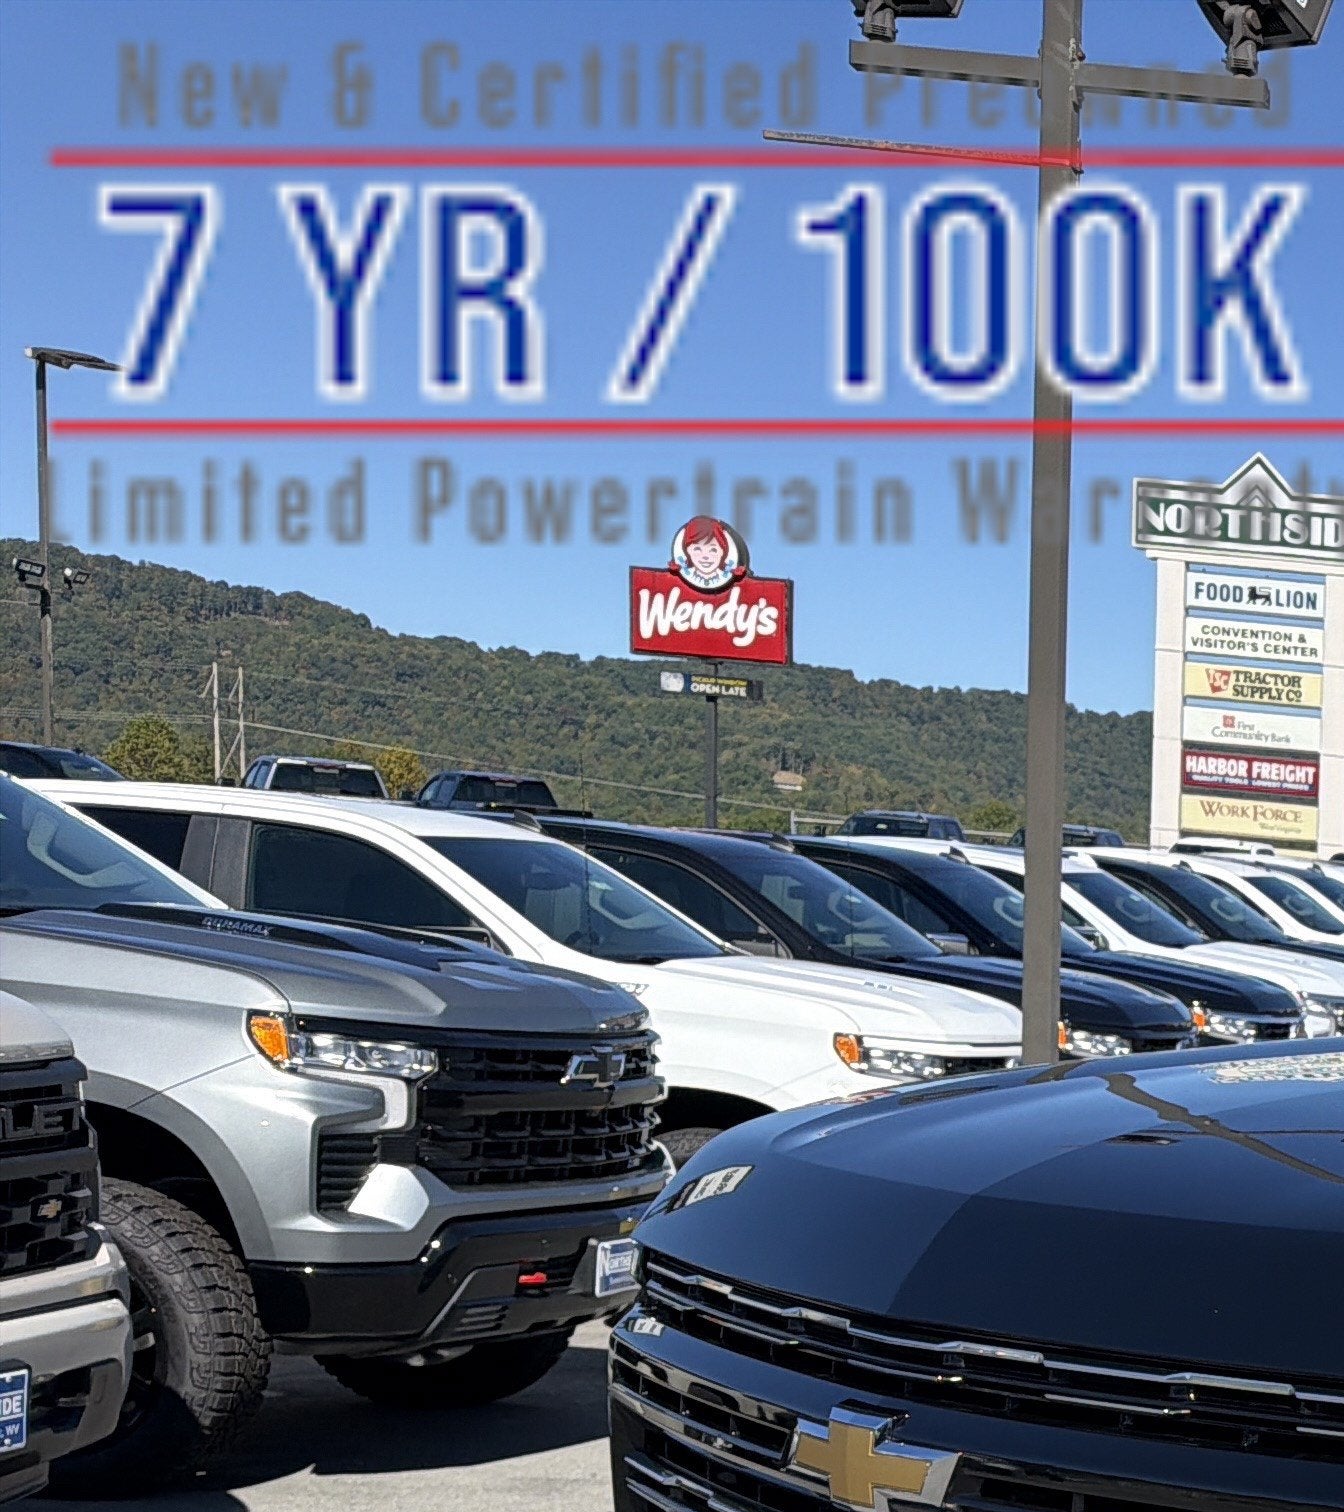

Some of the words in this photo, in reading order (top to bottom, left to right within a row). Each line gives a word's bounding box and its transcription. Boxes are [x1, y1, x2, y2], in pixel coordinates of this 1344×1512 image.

[1194, 581, 1244, 603] FOOD
[1276, 588, 1318, 610] LION
[639, 587, 779, 647] Wendy's
[1200, 624, 1293, 643] CONVENTION
[1297, 633, 1307, 644] &
[1191, 636, 1259, 652] VISITOR'S
[1263, 643, 1319, 658] CENTER
[1232, 669, 1303, 689] TRACTOR
[690, 682, 720, 694] OPEN
[721, 685, 747, 697] LATE
[1232, 684, 1285, 700] SUPPLY
[1211, 726, 1271, 743] Community
[1271, 733, 1291, 744] Bank
[1185, 755, 1249, 778] HARBOR
[1251, 760, 1317, 784] FREIGHT
